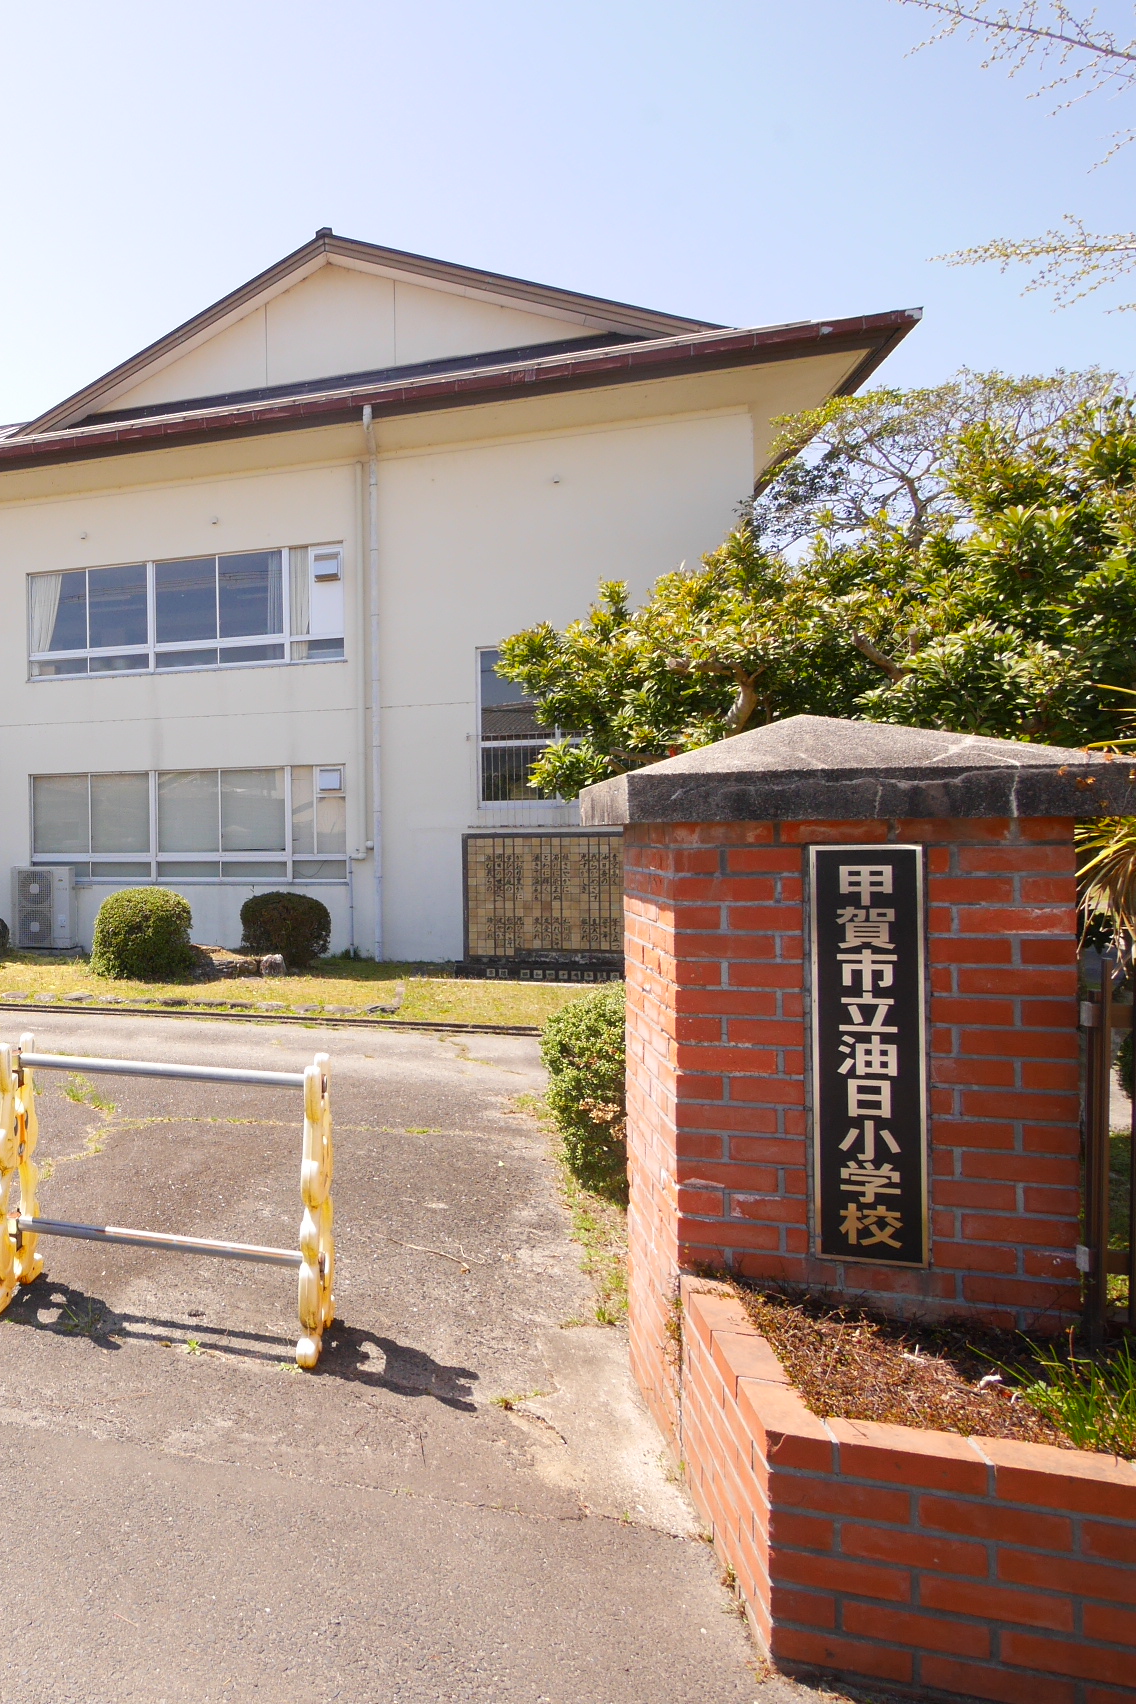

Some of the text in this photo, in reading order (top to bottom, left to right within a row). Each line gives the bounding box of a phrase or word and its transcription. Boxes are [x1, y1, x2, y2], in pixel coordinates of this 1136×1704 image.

[836, 864, 903, 1250] 甲賀市立油日小学校
